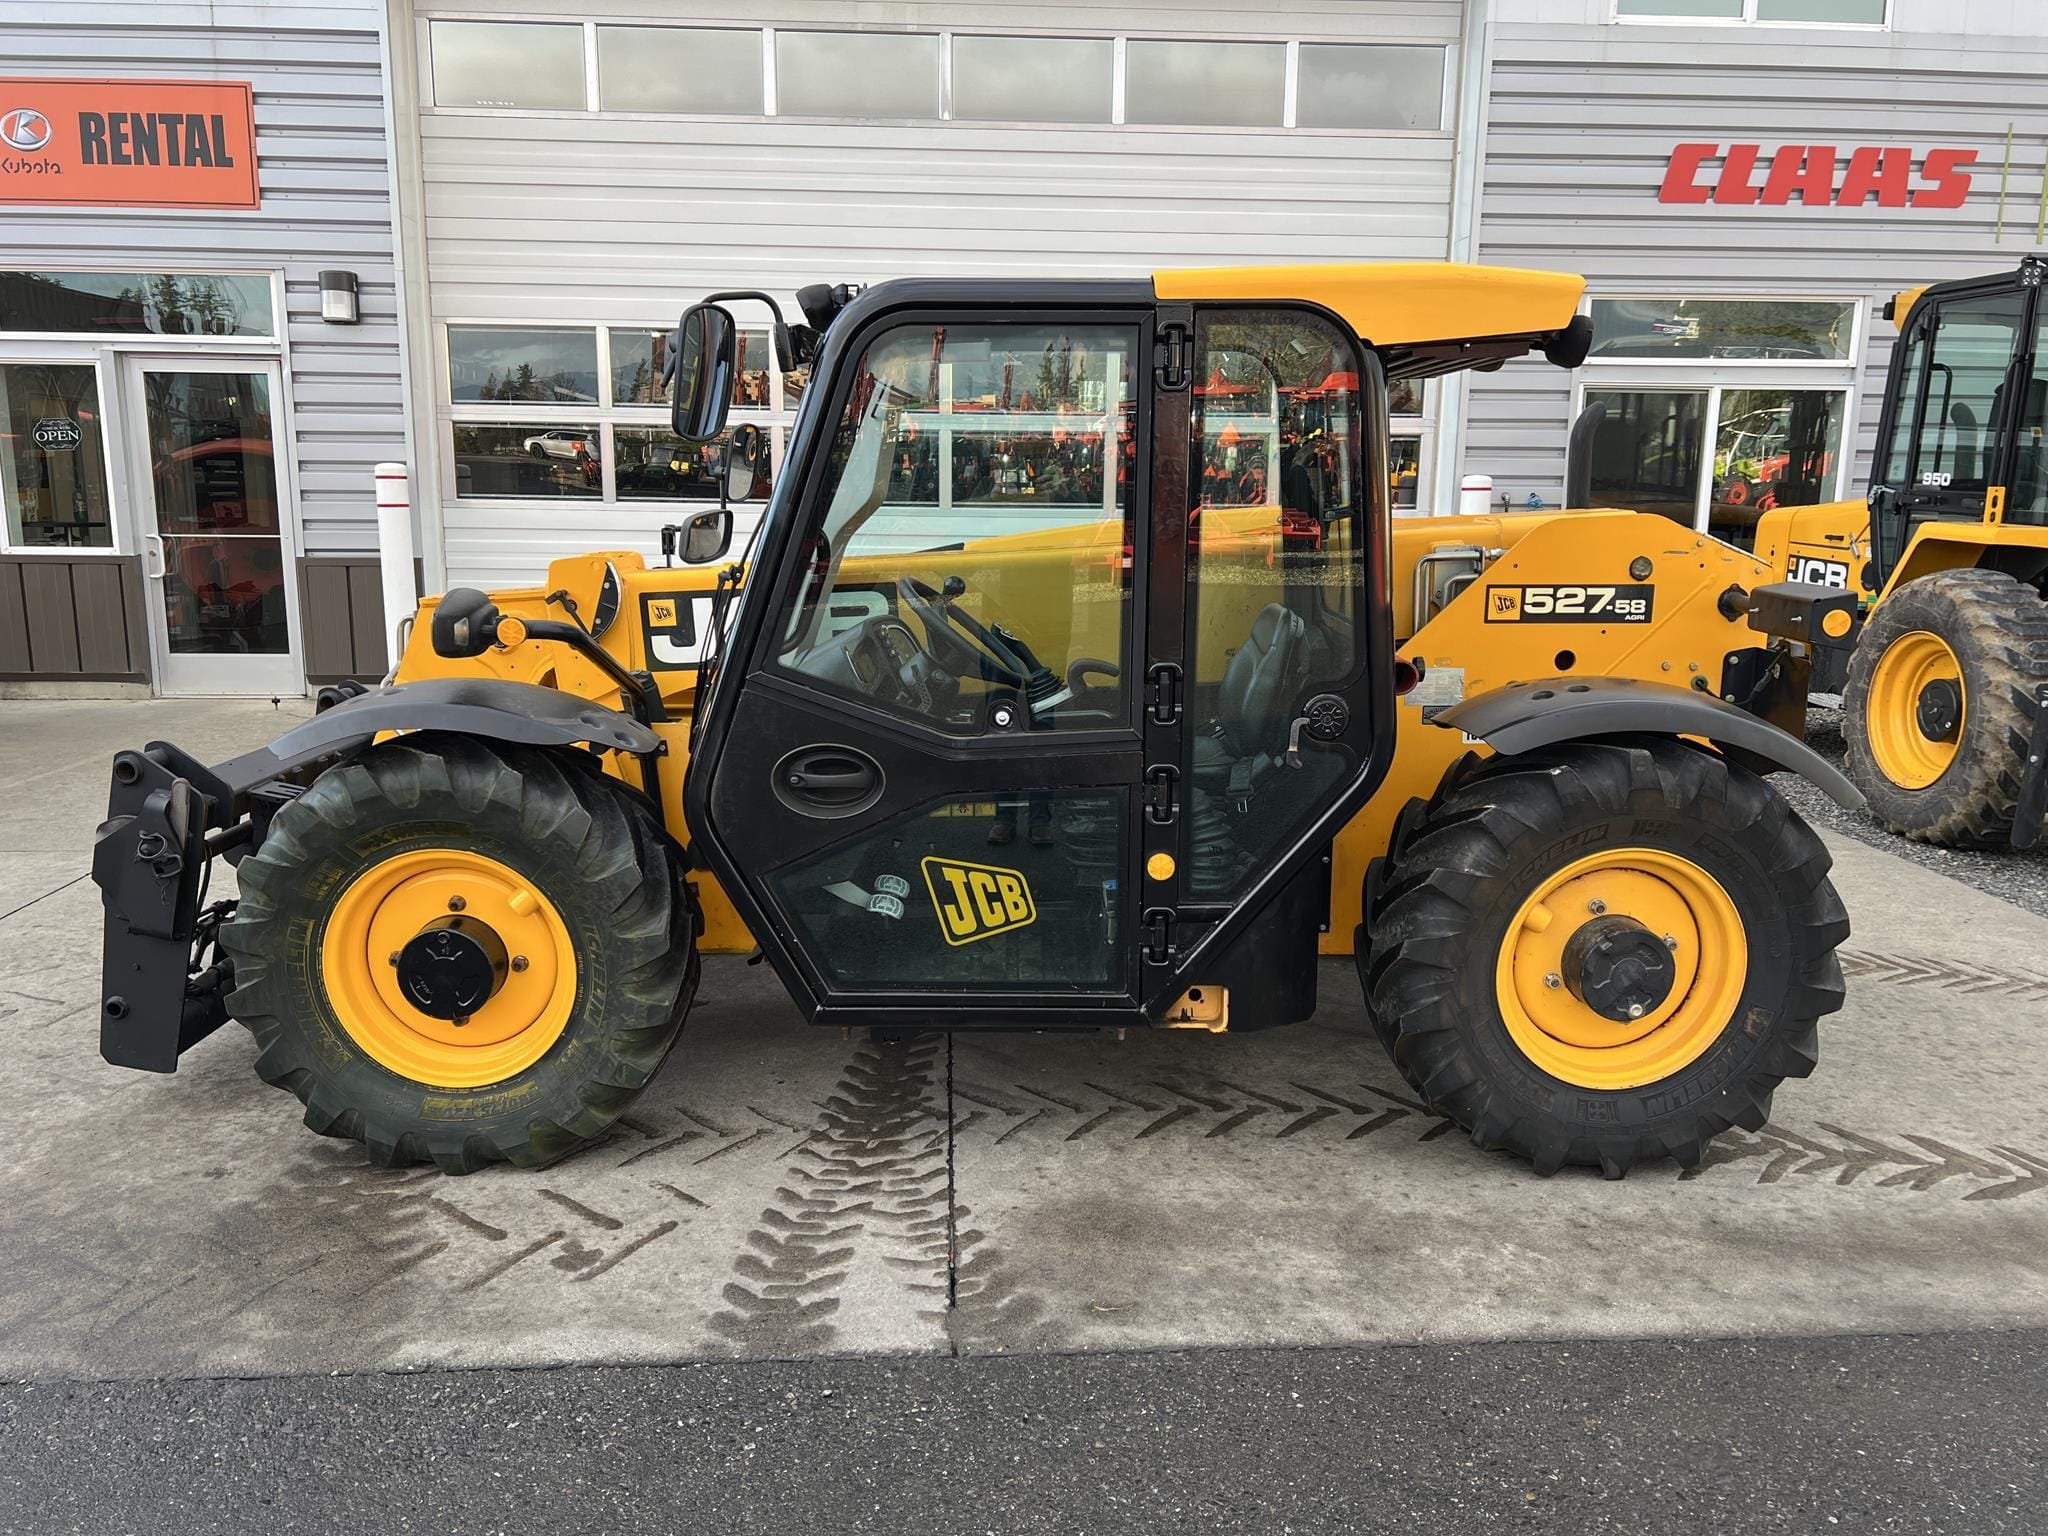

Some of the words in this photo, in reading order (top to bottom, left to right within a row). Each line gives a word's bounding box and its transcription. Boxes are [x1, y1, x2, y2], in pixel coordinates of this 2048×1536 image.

[78, 111, 234, 168] RENTAL
[0, 157, 62, 175] Kubota
[1658, 143, 1979, 208] CLAAS
[35, 430, 79, 442] OPEN
[1922, 472, 1951, 486] 950
[1787, 558, 1847, 589] JCB
[1497, 596, 1515, 611] JCB
[1523, 587, 1647, 614] 527-58
[655, 606, 673, 620] JCB
[1624, 613, 1645, 621] AGRI
[941, 866, 1028, 936] JCB
